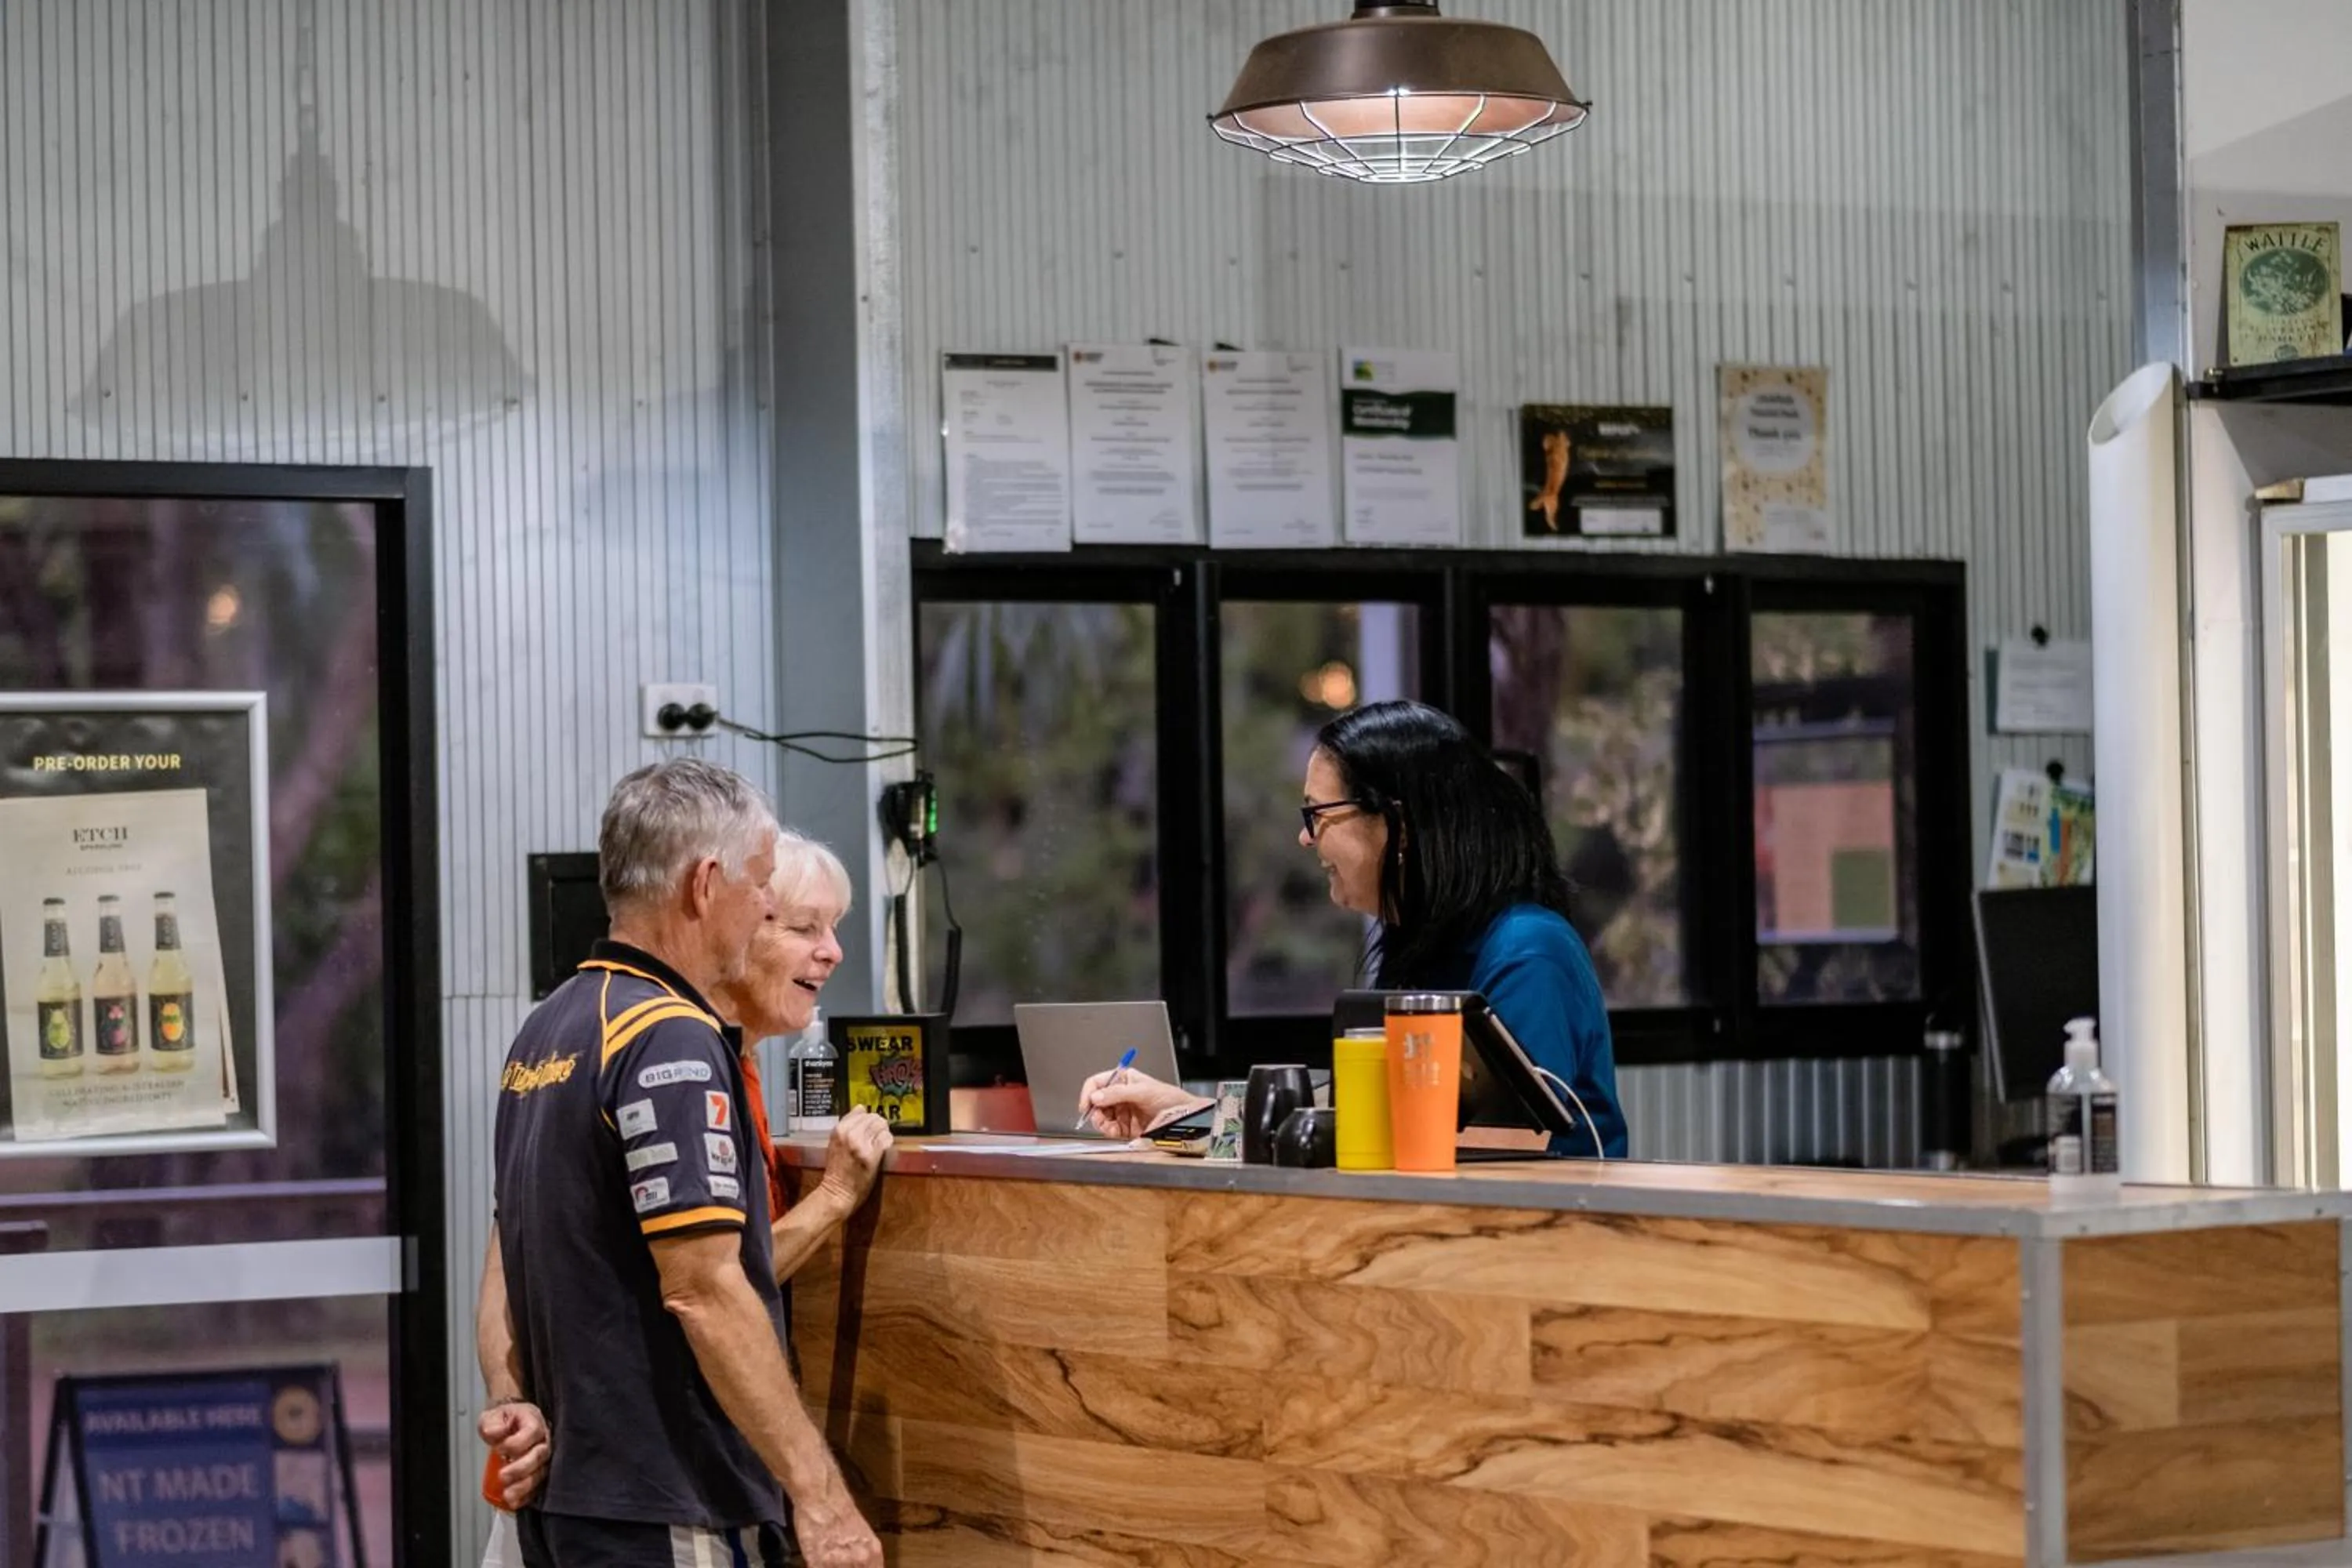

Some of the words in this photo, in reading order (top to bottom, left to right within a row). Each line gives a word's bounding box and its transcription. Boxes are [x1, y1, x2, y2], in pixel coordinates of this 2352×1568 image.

[2244, 231, 2325, 252] WATTLE
[33, 755, 131, 771] PRE-ORDER
[134, 753, 181, 770] YOUR
[73, 826, 129, 843] ETCH
[847, 1036, 913, 1052] SWEAR
[85, 1408, 201, 1432] AVAILABLE
[206, 1404, 263, 1427] HERE
[97, 1468, 147, 1503] NT
[155, 1463, 257, 1500] MADE
[114, 1516, 255, 1555] FROZEN
